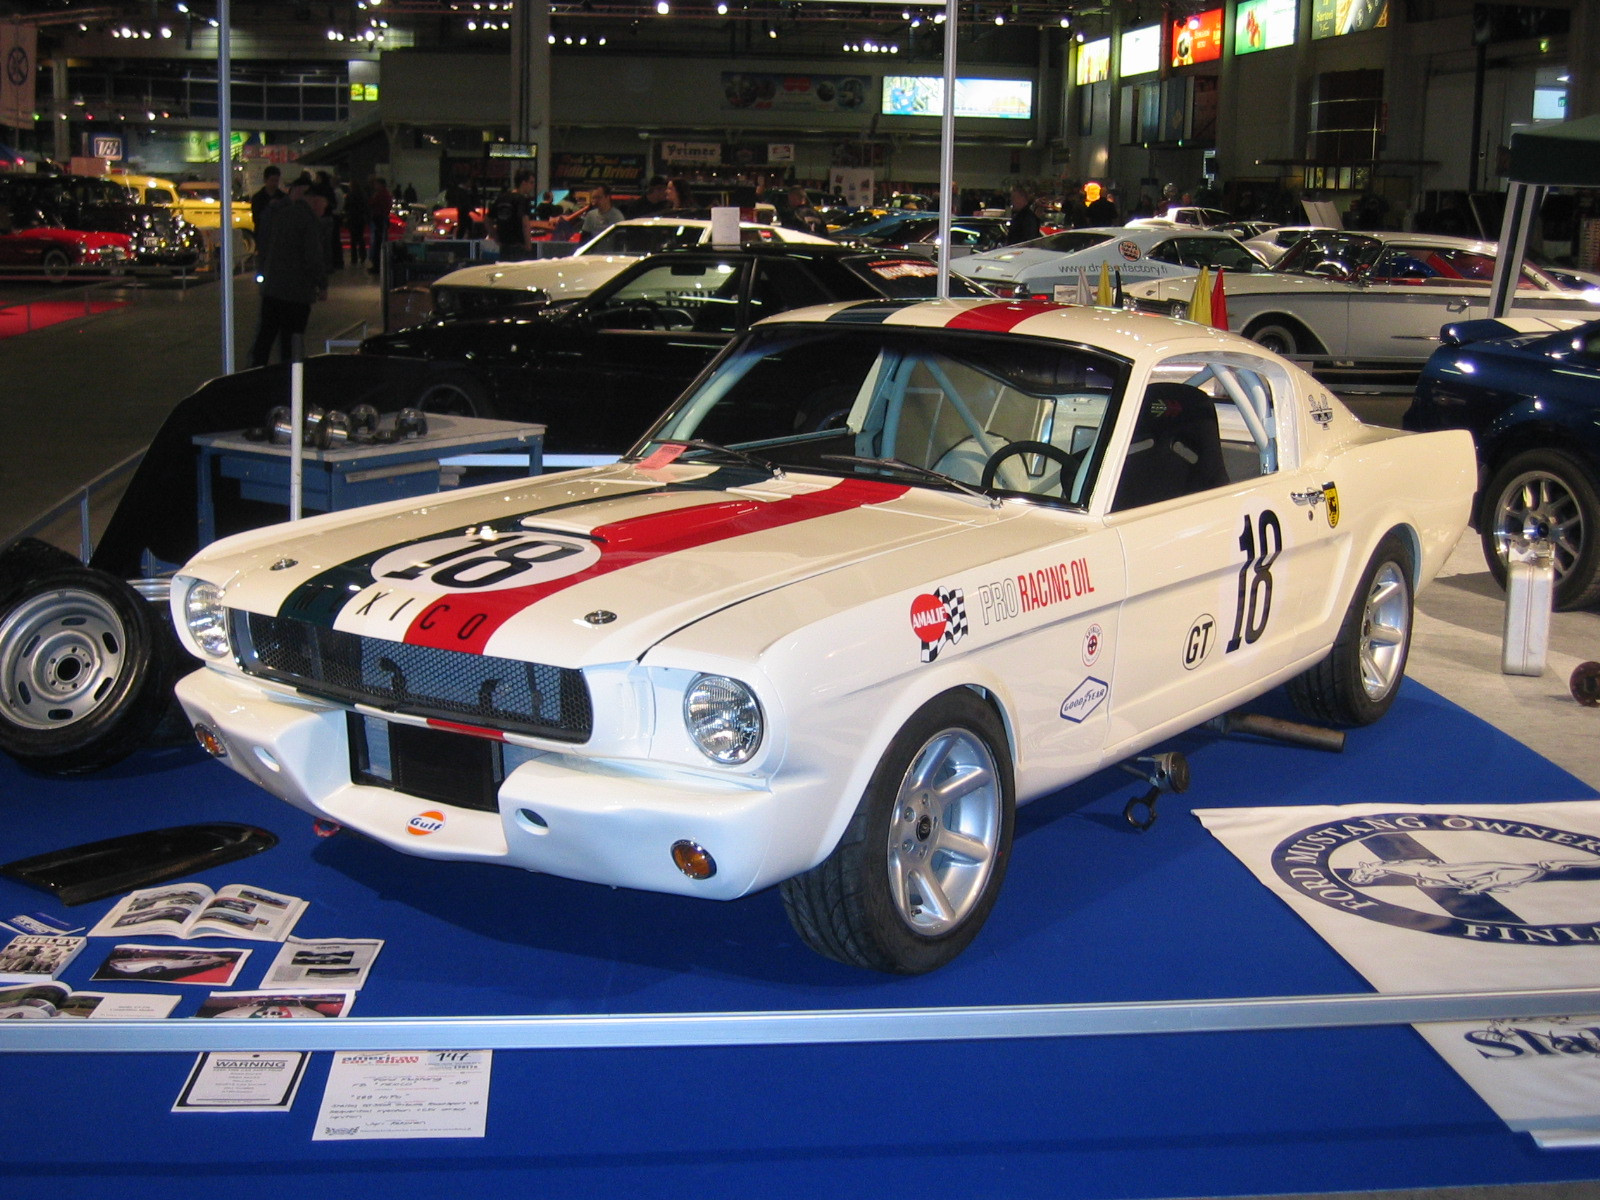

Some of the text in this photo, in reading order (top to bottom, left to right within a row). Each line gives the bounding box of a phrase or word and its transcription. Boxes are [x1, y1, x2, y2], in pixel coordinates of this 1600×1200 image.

[1058, 263, 1168, 276] wwwdrafactory.fi
[382, 535, 585, 588] 18
[1225, 509, 1283, 654] 18
[978, 557, 1095, 625] PRO RACING OIL
[912, 606, 947, 628] AMALIE
[1185, 621, 1213, 664] GT
[410, 817, 442, 831] Gulf
[1285, 816, 1600, 911] FORD MUSTANG OWNER
[1464, 924, 1600, 943] FINL
